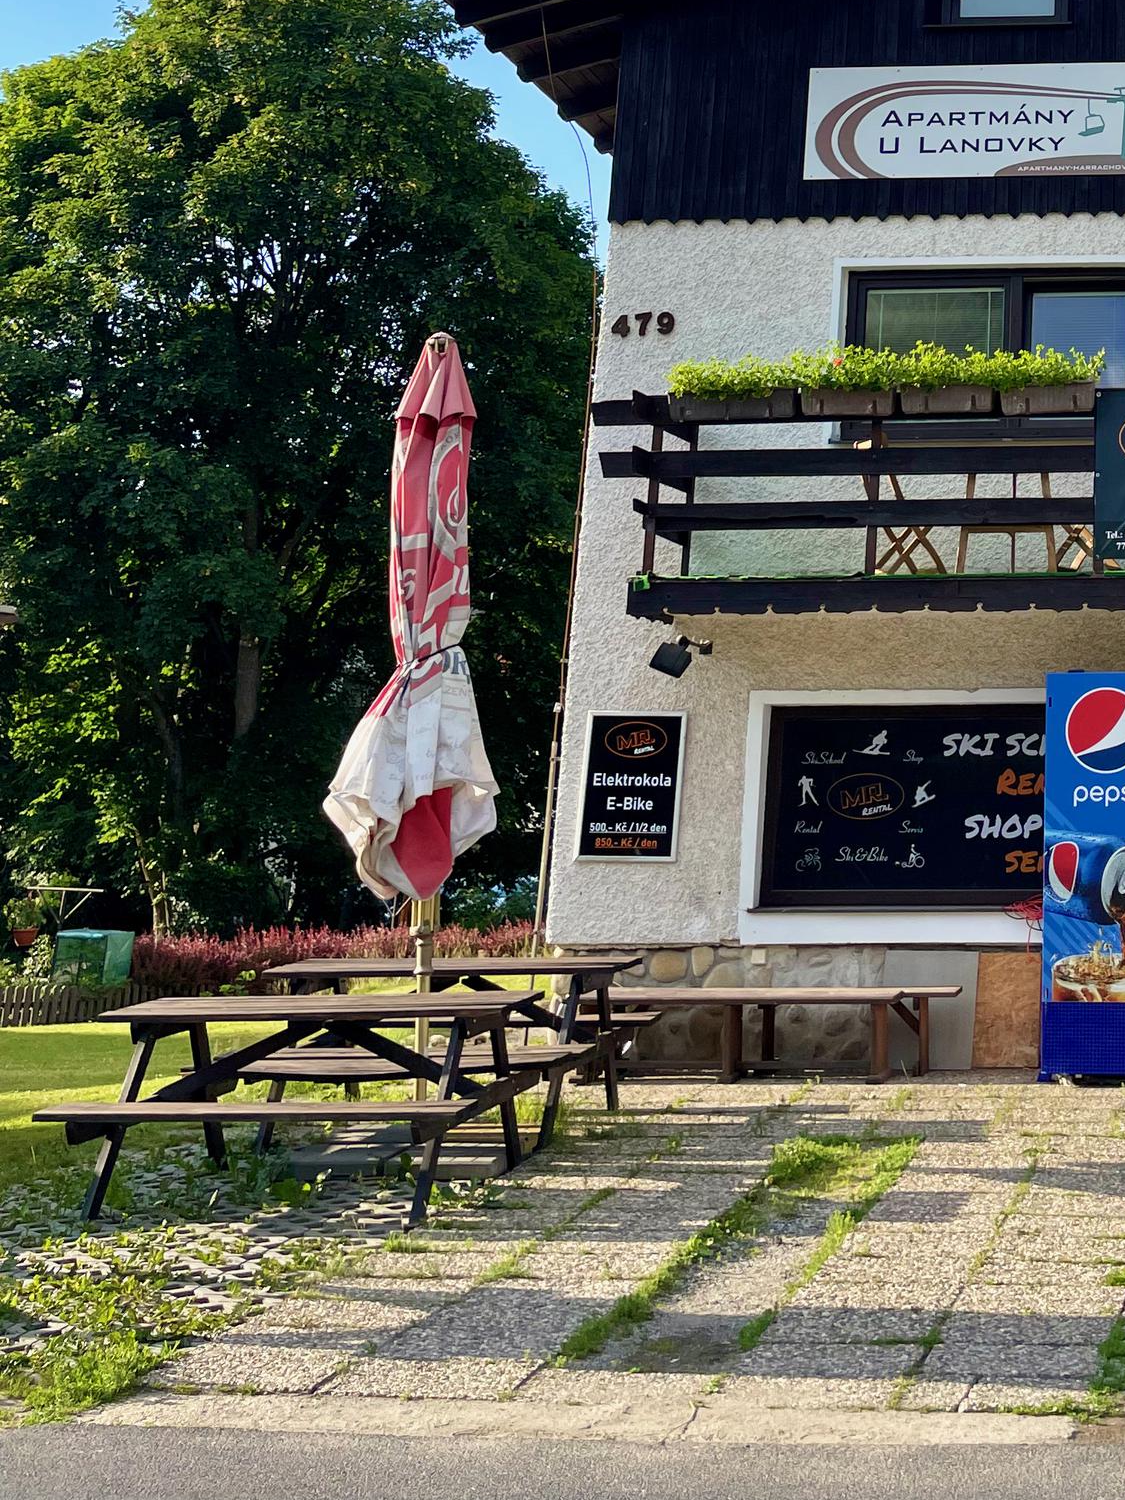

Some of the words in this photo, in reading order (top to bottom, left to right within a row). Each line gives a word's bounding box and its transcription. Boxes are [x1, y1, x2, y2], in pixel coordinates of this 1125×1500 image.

[881, 103, 1075, 127] APARTMÁNY
[879, 136, 900, 154] U
[919, 136, 1066, 154] LANOVKY
[611, 311, 675, 338] 479
[942, 733, 1000, 757] SKI
[903, 749, 924, 764] Shop
[593, 773, 672, 787] Elektrokola
[606, 797, 654, 810] E-Bike
[862, 803, 893, 816] RENTAL
[615, 822, 627, 832] Kč
[635, 822, 648, 832] 1/2
[650, 823, 667, 832] den
[794, 820, 823, 834] Rental
[898, 820, 924, 834] Servis
[964, 814, 1043, 839] SHOP
[641, 838, 658, 847] den
